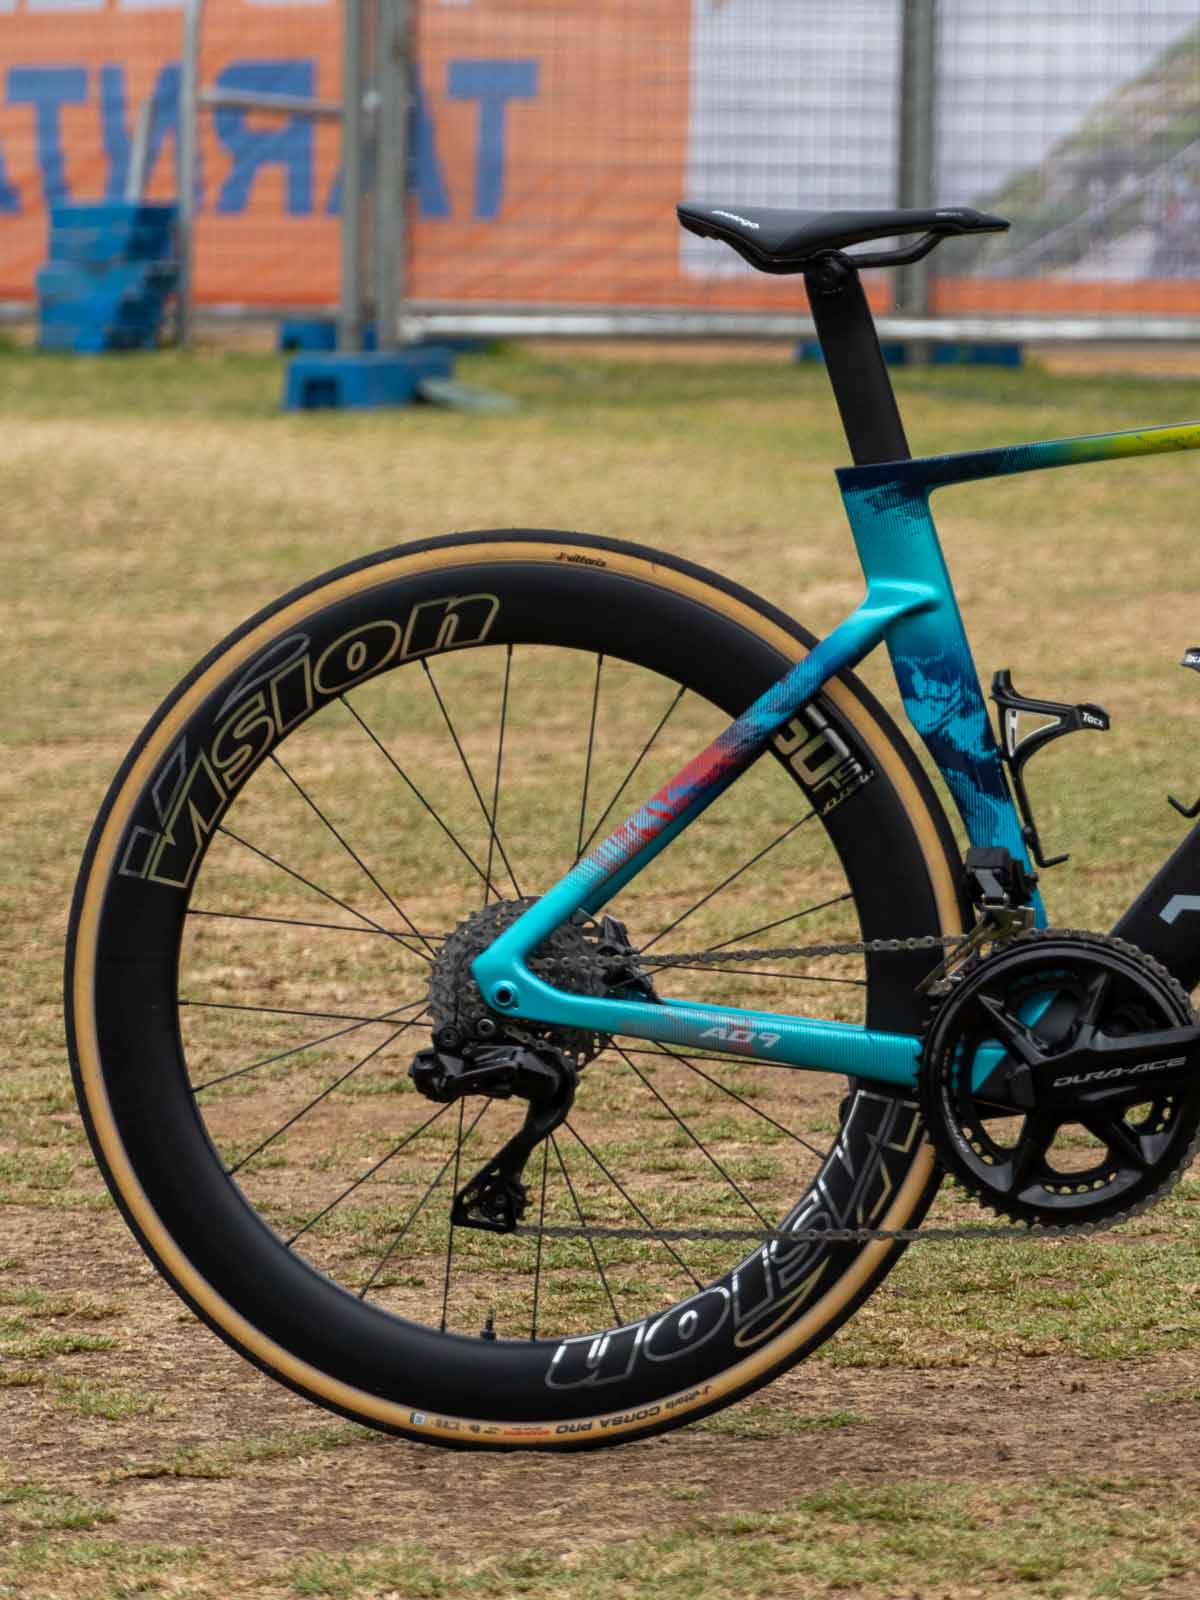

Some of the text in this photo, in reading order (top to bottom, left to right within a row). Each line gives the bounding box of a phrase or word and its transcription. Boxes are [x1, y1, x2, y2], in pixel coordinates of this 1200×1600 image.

[1082, 711, 1105, 727] Tacx
[119, 593, 499, 888] Vision
[1053, 1056, 1187, 1088] DURA-ACE
[545, 1089, 920, 1388] Vision
[555, 1421, 593, 1435] PRO
[600, 1406, 660, 1429] CORSA
